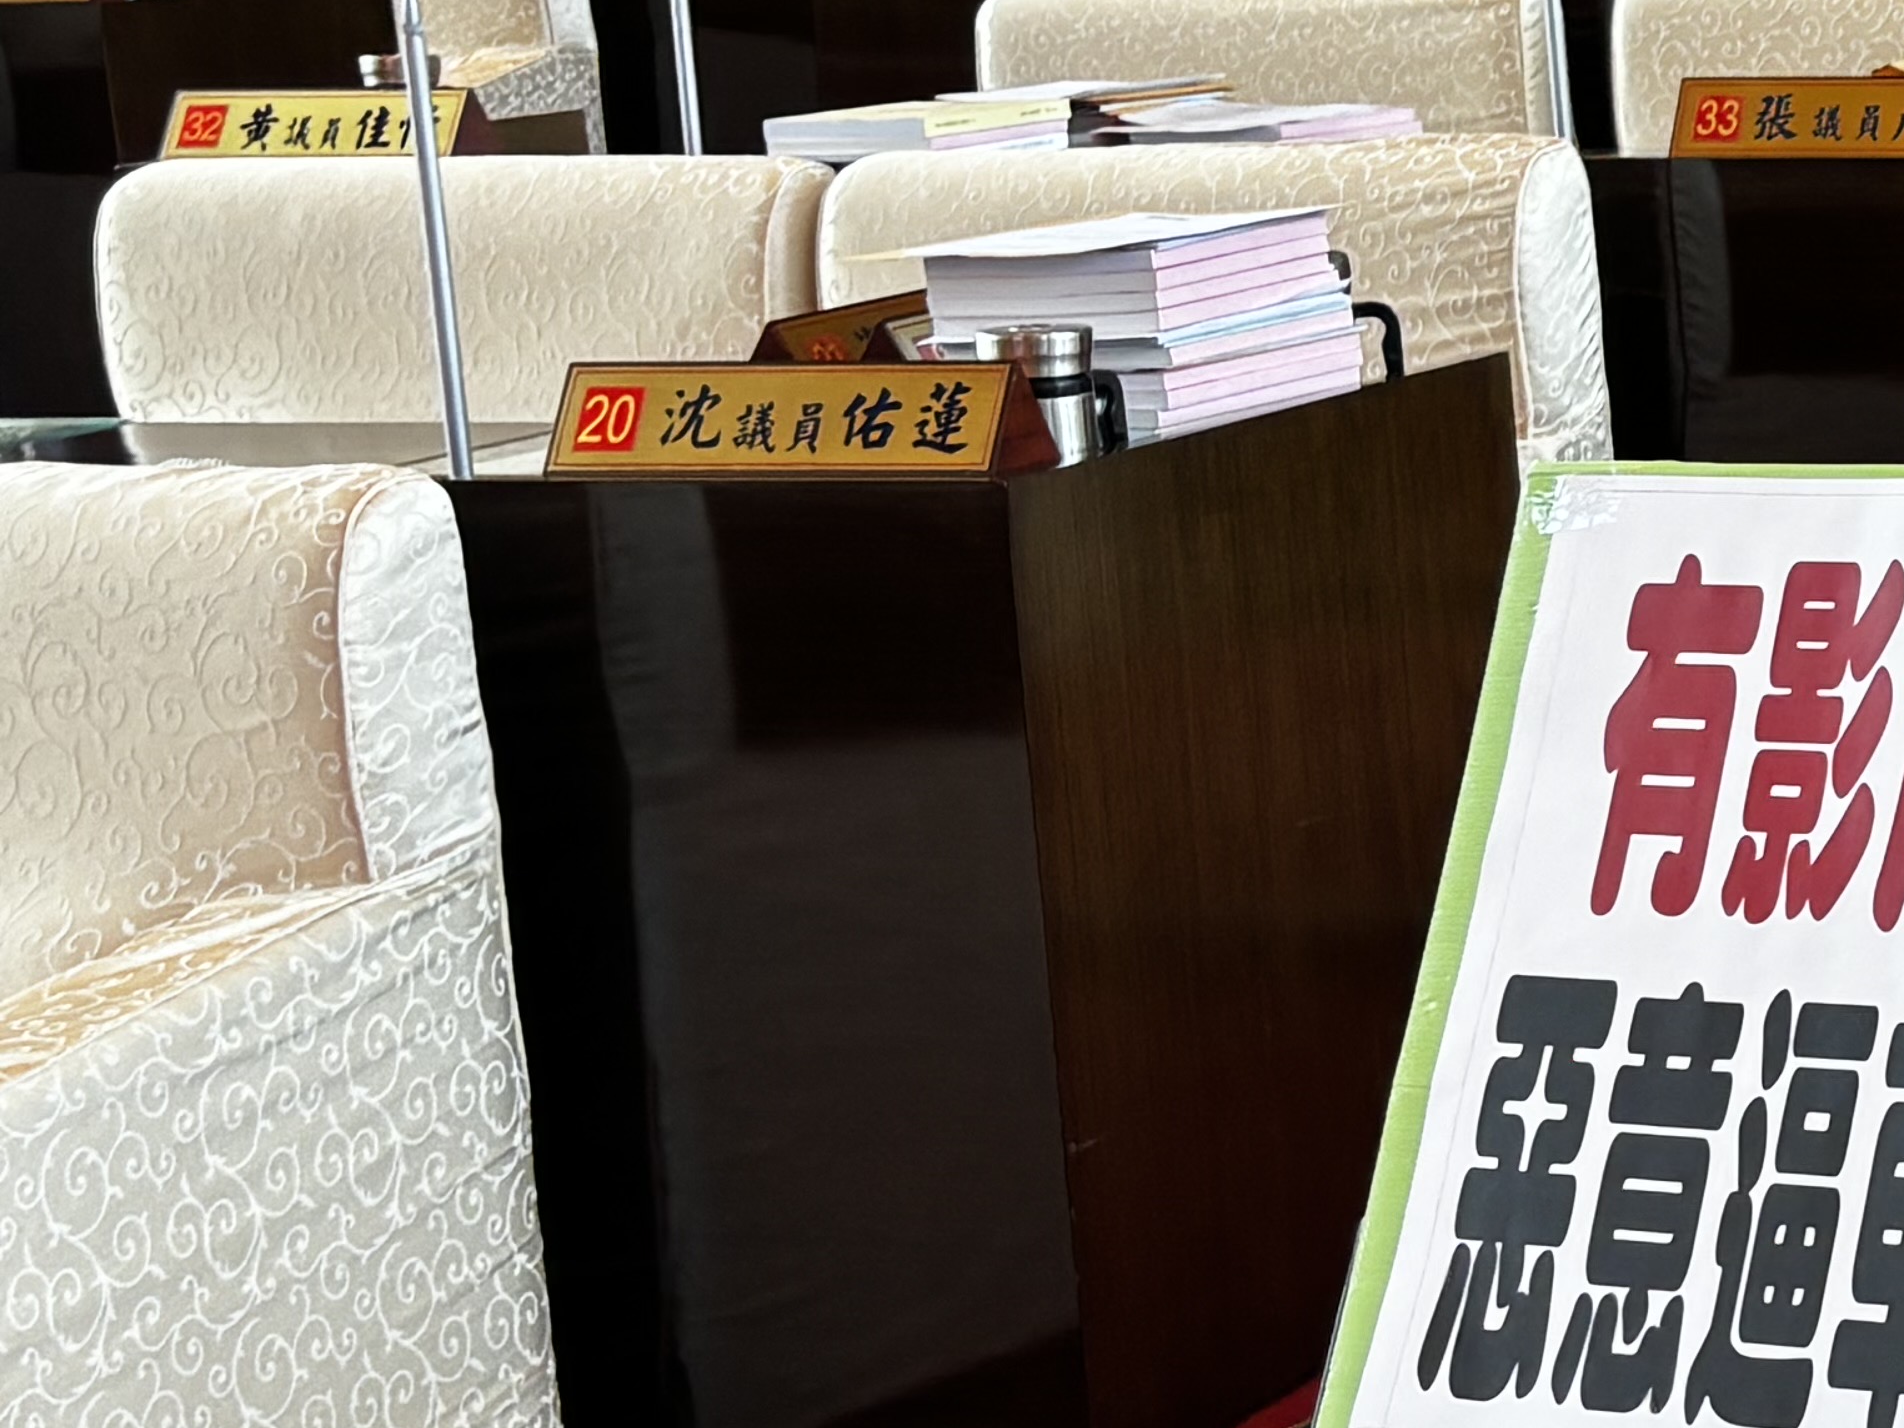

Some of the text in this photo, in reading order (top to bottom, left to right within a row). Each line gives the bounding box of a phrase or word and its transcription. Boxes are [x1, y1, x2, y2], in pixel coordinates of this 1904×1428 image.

[184, 109, 224, 145] 32
[1695, 99, 1742, 139] 33
[580, 382, 974, 456] 20 沈議員佑蓮
